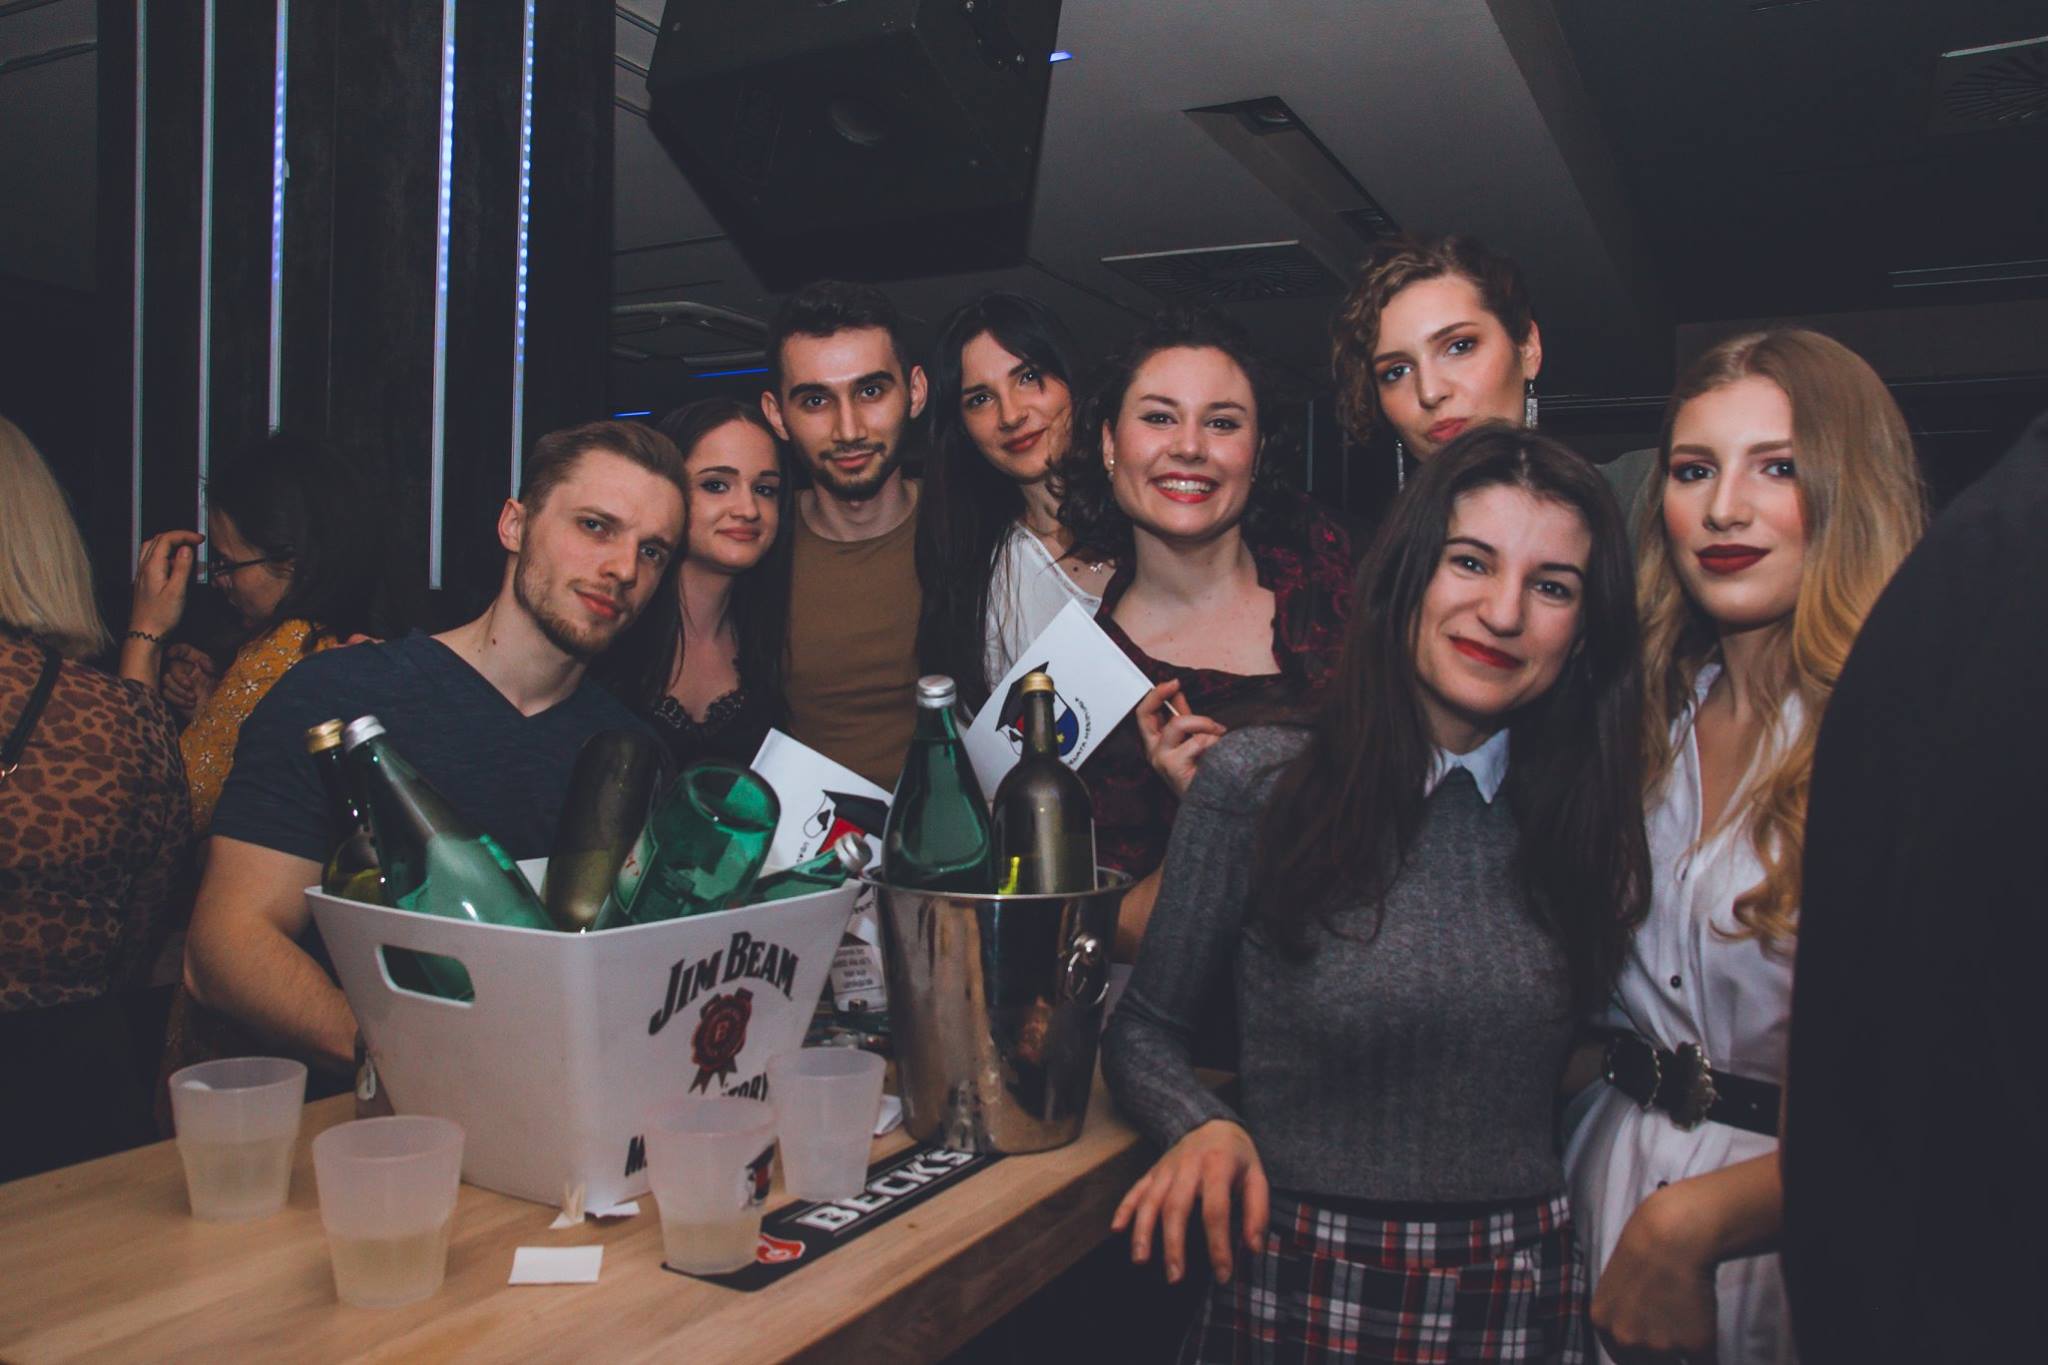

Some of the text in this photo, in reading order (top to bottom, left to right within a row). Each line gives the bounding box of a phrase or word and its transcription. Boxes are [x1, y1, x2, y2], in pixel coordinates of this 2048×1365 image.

[648, 931, 799, 1036] JIM BEAM
[795, 1150, 973, 1232] BECK'S
